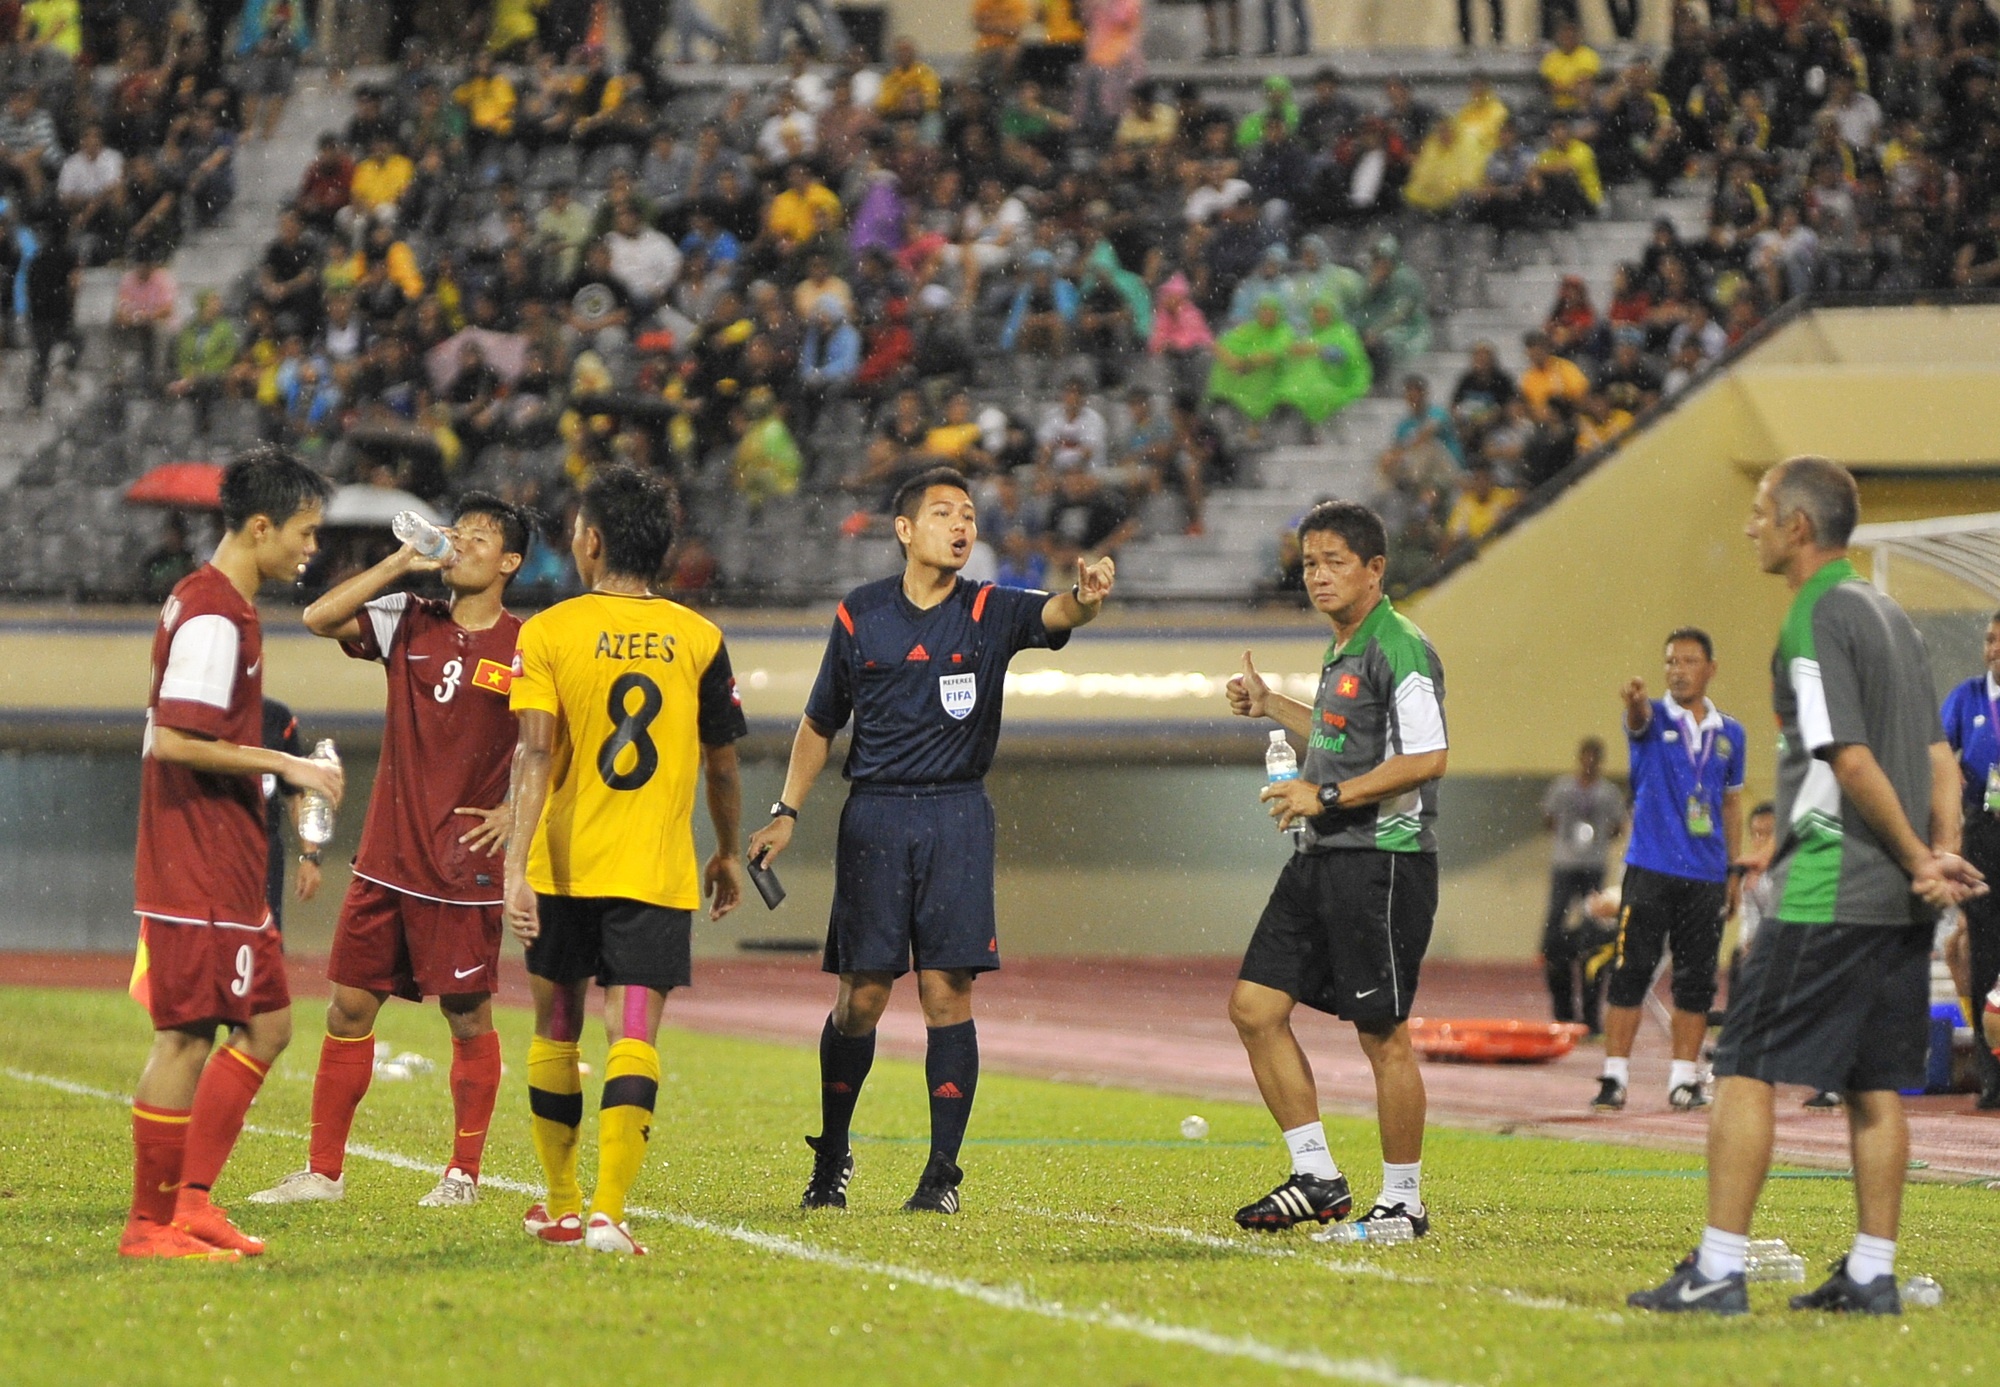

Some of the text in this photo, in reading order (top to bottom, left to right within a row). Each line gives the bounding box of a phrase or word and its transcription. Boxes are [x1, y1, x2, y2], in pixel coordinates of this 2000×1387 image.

[595, 631, 675, 663] AZEES
[433, 660, 463, 703] 3
[943, 677, 973, 685] REFEREE
[946, 690, 972, 702] FIFA
[597, 672, 662, 792] 8
[230, 944, 253, 997] 9
